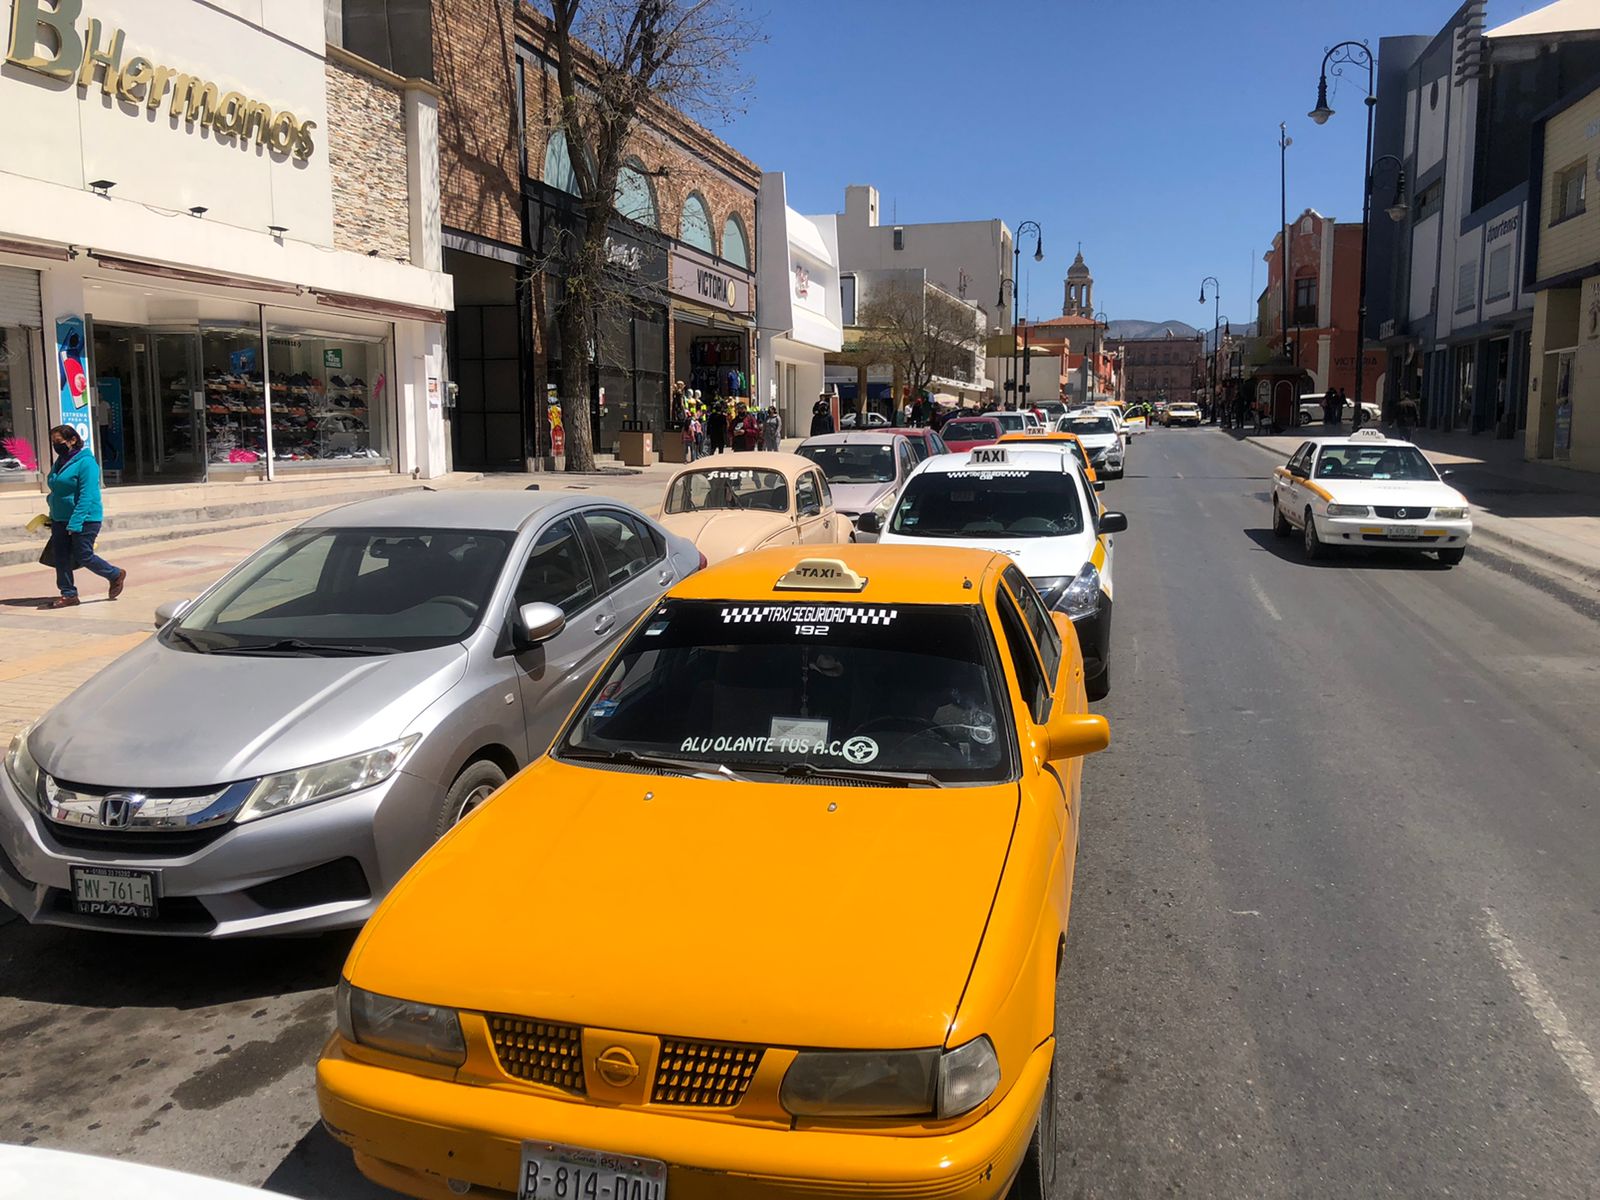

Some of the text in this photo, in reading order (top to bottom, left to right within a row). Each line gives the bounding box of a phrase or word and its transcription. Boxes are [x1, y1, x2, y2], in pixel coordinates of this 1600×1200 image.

[77, 17, 317, 160] Hermanos
[697, 268, 728, 303] VICTORIA
[1334, 357, 1377, 367] VICTRIA
[1027, 427, 1045, 435] TAXI
[974, 450, 1005, 462] TAXI
[801, 568, 835, 578] TAXI
[768, 606, 847, 623] TAXI SEGURIDAD
[794, 625, 830, 636] 192
[780, 737, 810, 754] TUS
[812, 740, 843, 756] A.C.
[75, 878, 152, 904] FMV-761-A
[90, 903, 139, 917] PLAZA
